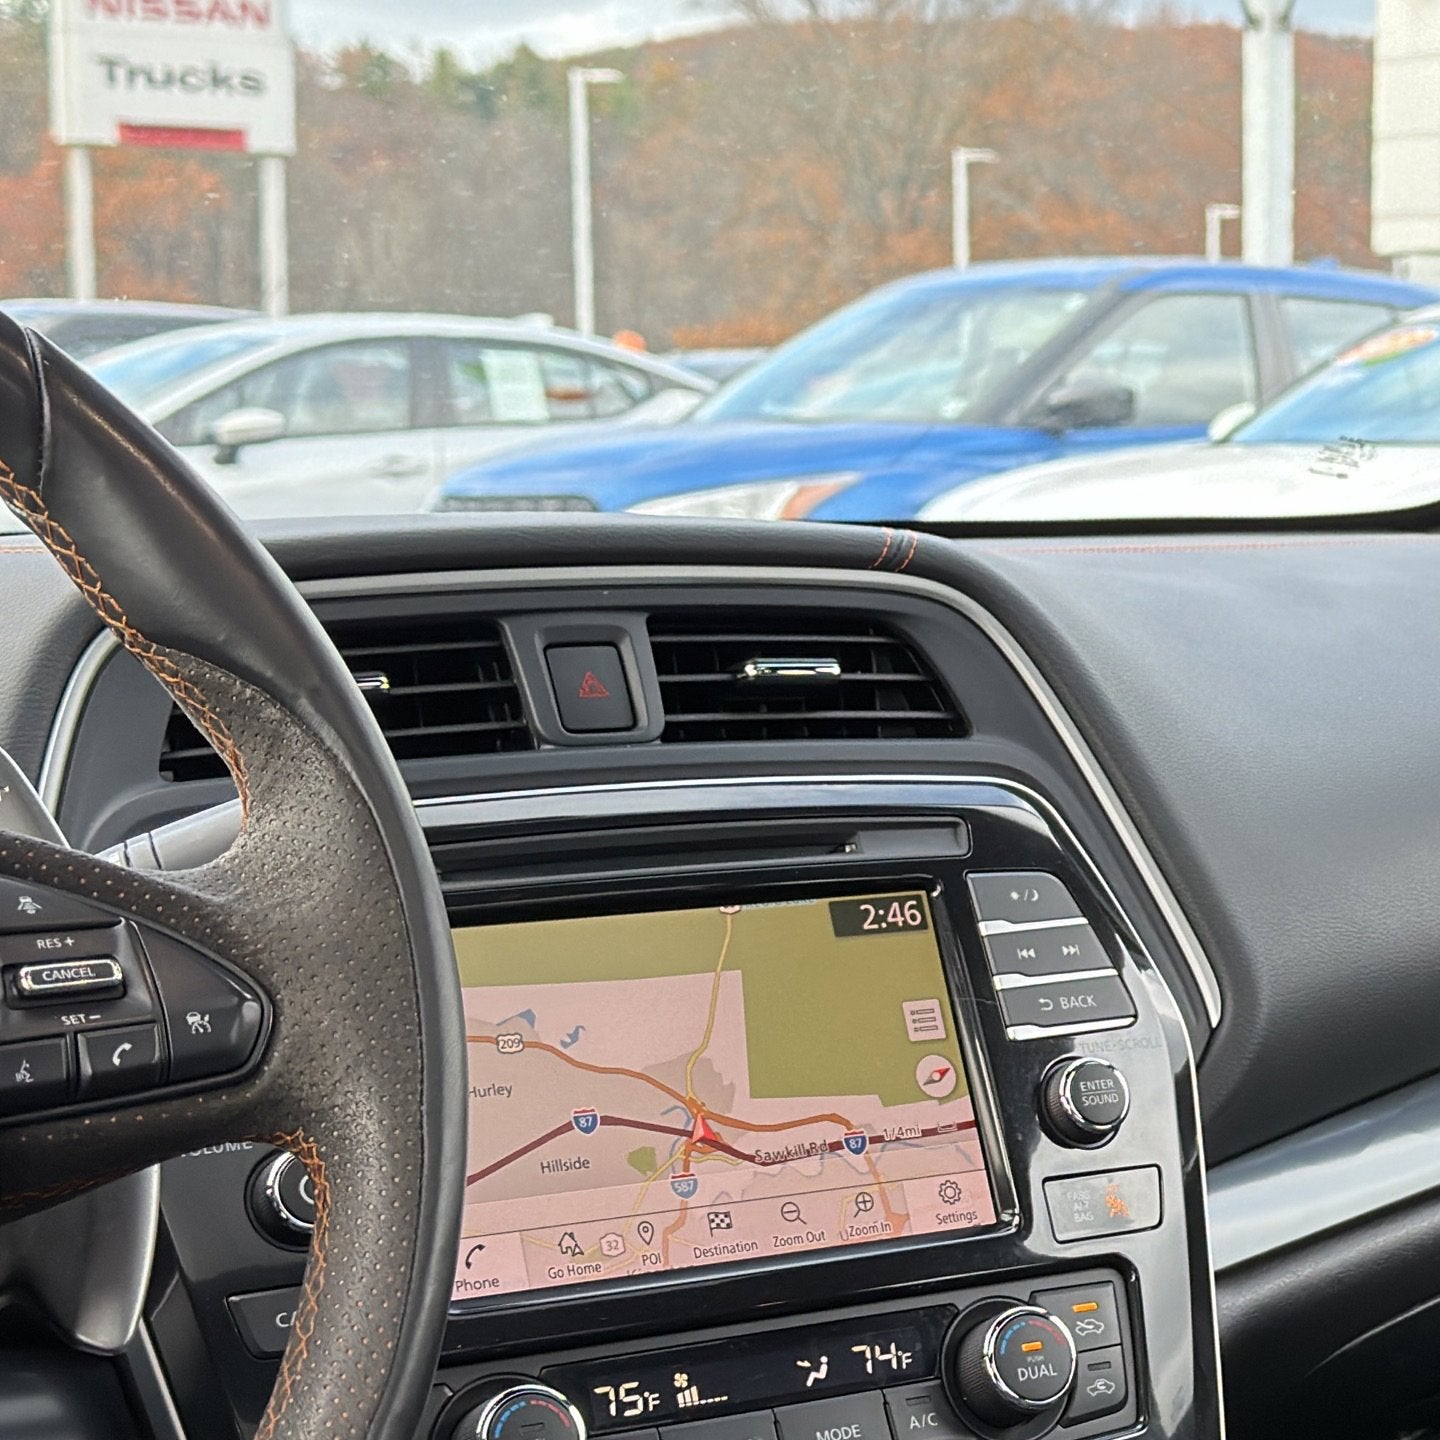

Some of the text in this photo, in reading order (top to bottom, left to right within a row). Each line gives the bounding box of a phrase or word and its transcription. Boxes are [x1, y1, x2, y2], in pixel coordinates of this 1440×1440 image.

[95, 53, 266, 97] Trucks
[860, 900, 922, 930] 2:46
[37, 938, 62, 949] RES
[42, 967, 96, 981] CANCEL
[1060, 995, 1097, 1009] BACK
[61, 1014, 86, 1025] SET
[499, 1037, 521, 1050] 209
[1080, 1079, 1114, 1091] ENTER
[1082, 1093, 1119, 1106] SOUND
[578, 1115, 593, 1128] 87
[809, 1139, 828, 1152] Rd
[849, 1139, 862, 1149] 87
[540, 1156, 590, 1174] Hillside
[674, 1180, 694, 1192] 587
[936, 1210, 978, 1227] Settings
[1074, 1212, 1094, 1223] BAG
[848, 1222, 878, 1237] Zoom
[881, 1221, 892, 1233] In
[605, 1239, 620, 1251] 32
[773, 1234, 804, 1250] Zoom
[806, 1230, 826, 1245] Out
[693, 1239, 759, 1260] Destination
[641, 1252, 662, 1266] POI
[547, 1261, 602, 1280] Go Home
[455, 1275, 500, 1293] Phone
[1018, 1364, 1058, 1382] DUAL
[910, 1413, 938, 1429] A/C
